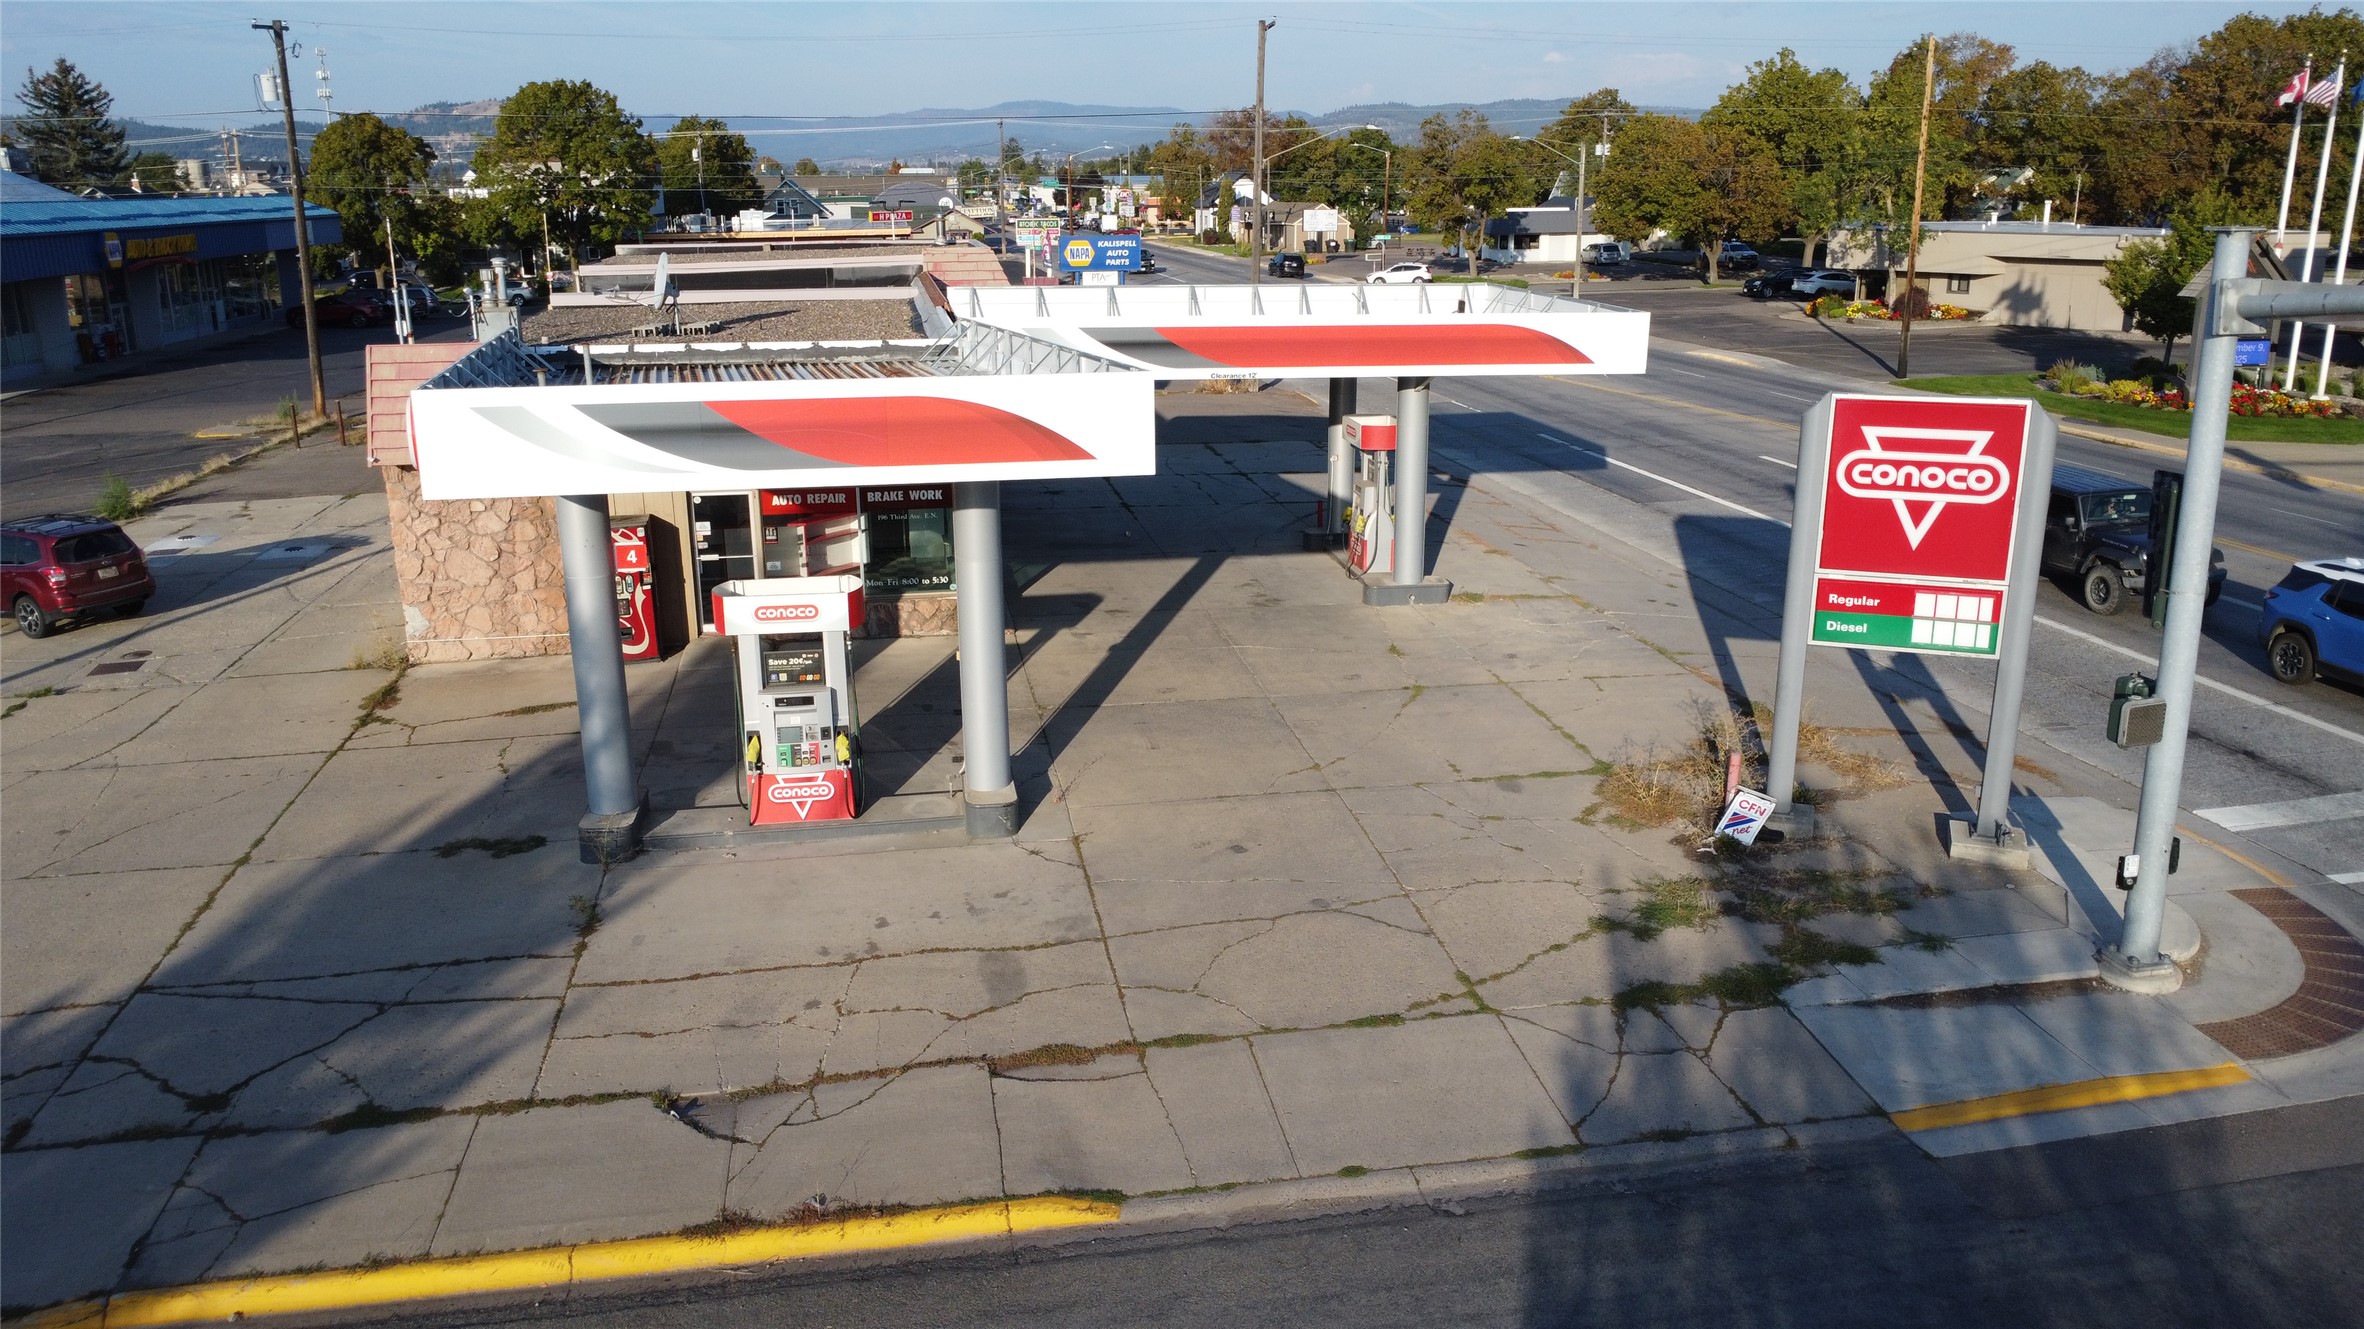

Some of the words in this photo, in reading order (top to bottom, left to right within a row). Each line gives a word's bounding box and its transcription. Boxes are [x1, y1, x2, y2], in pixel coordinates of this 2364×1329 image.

[1069, 247, 1090, 260] NAPA
[772, 494, 802, 506] AUTO
[807, 493, 846, 504] REPAIR
[867, 491, 904, 502] BRAKE
[909, 489, 943, 501] WORK
[626, 550, 638, 563] 4
[901, 577, 919, 585] 8:00
[932, 576, 949, 584] 5:30
[1828, 593, 1880, 607] Regular
[1826, 621, 1867, 633] Diesel
[768, 658, 787, 666] Save
[1738, 799, 1767, 817] CFN
[1732, 825, 1753, 836] net
